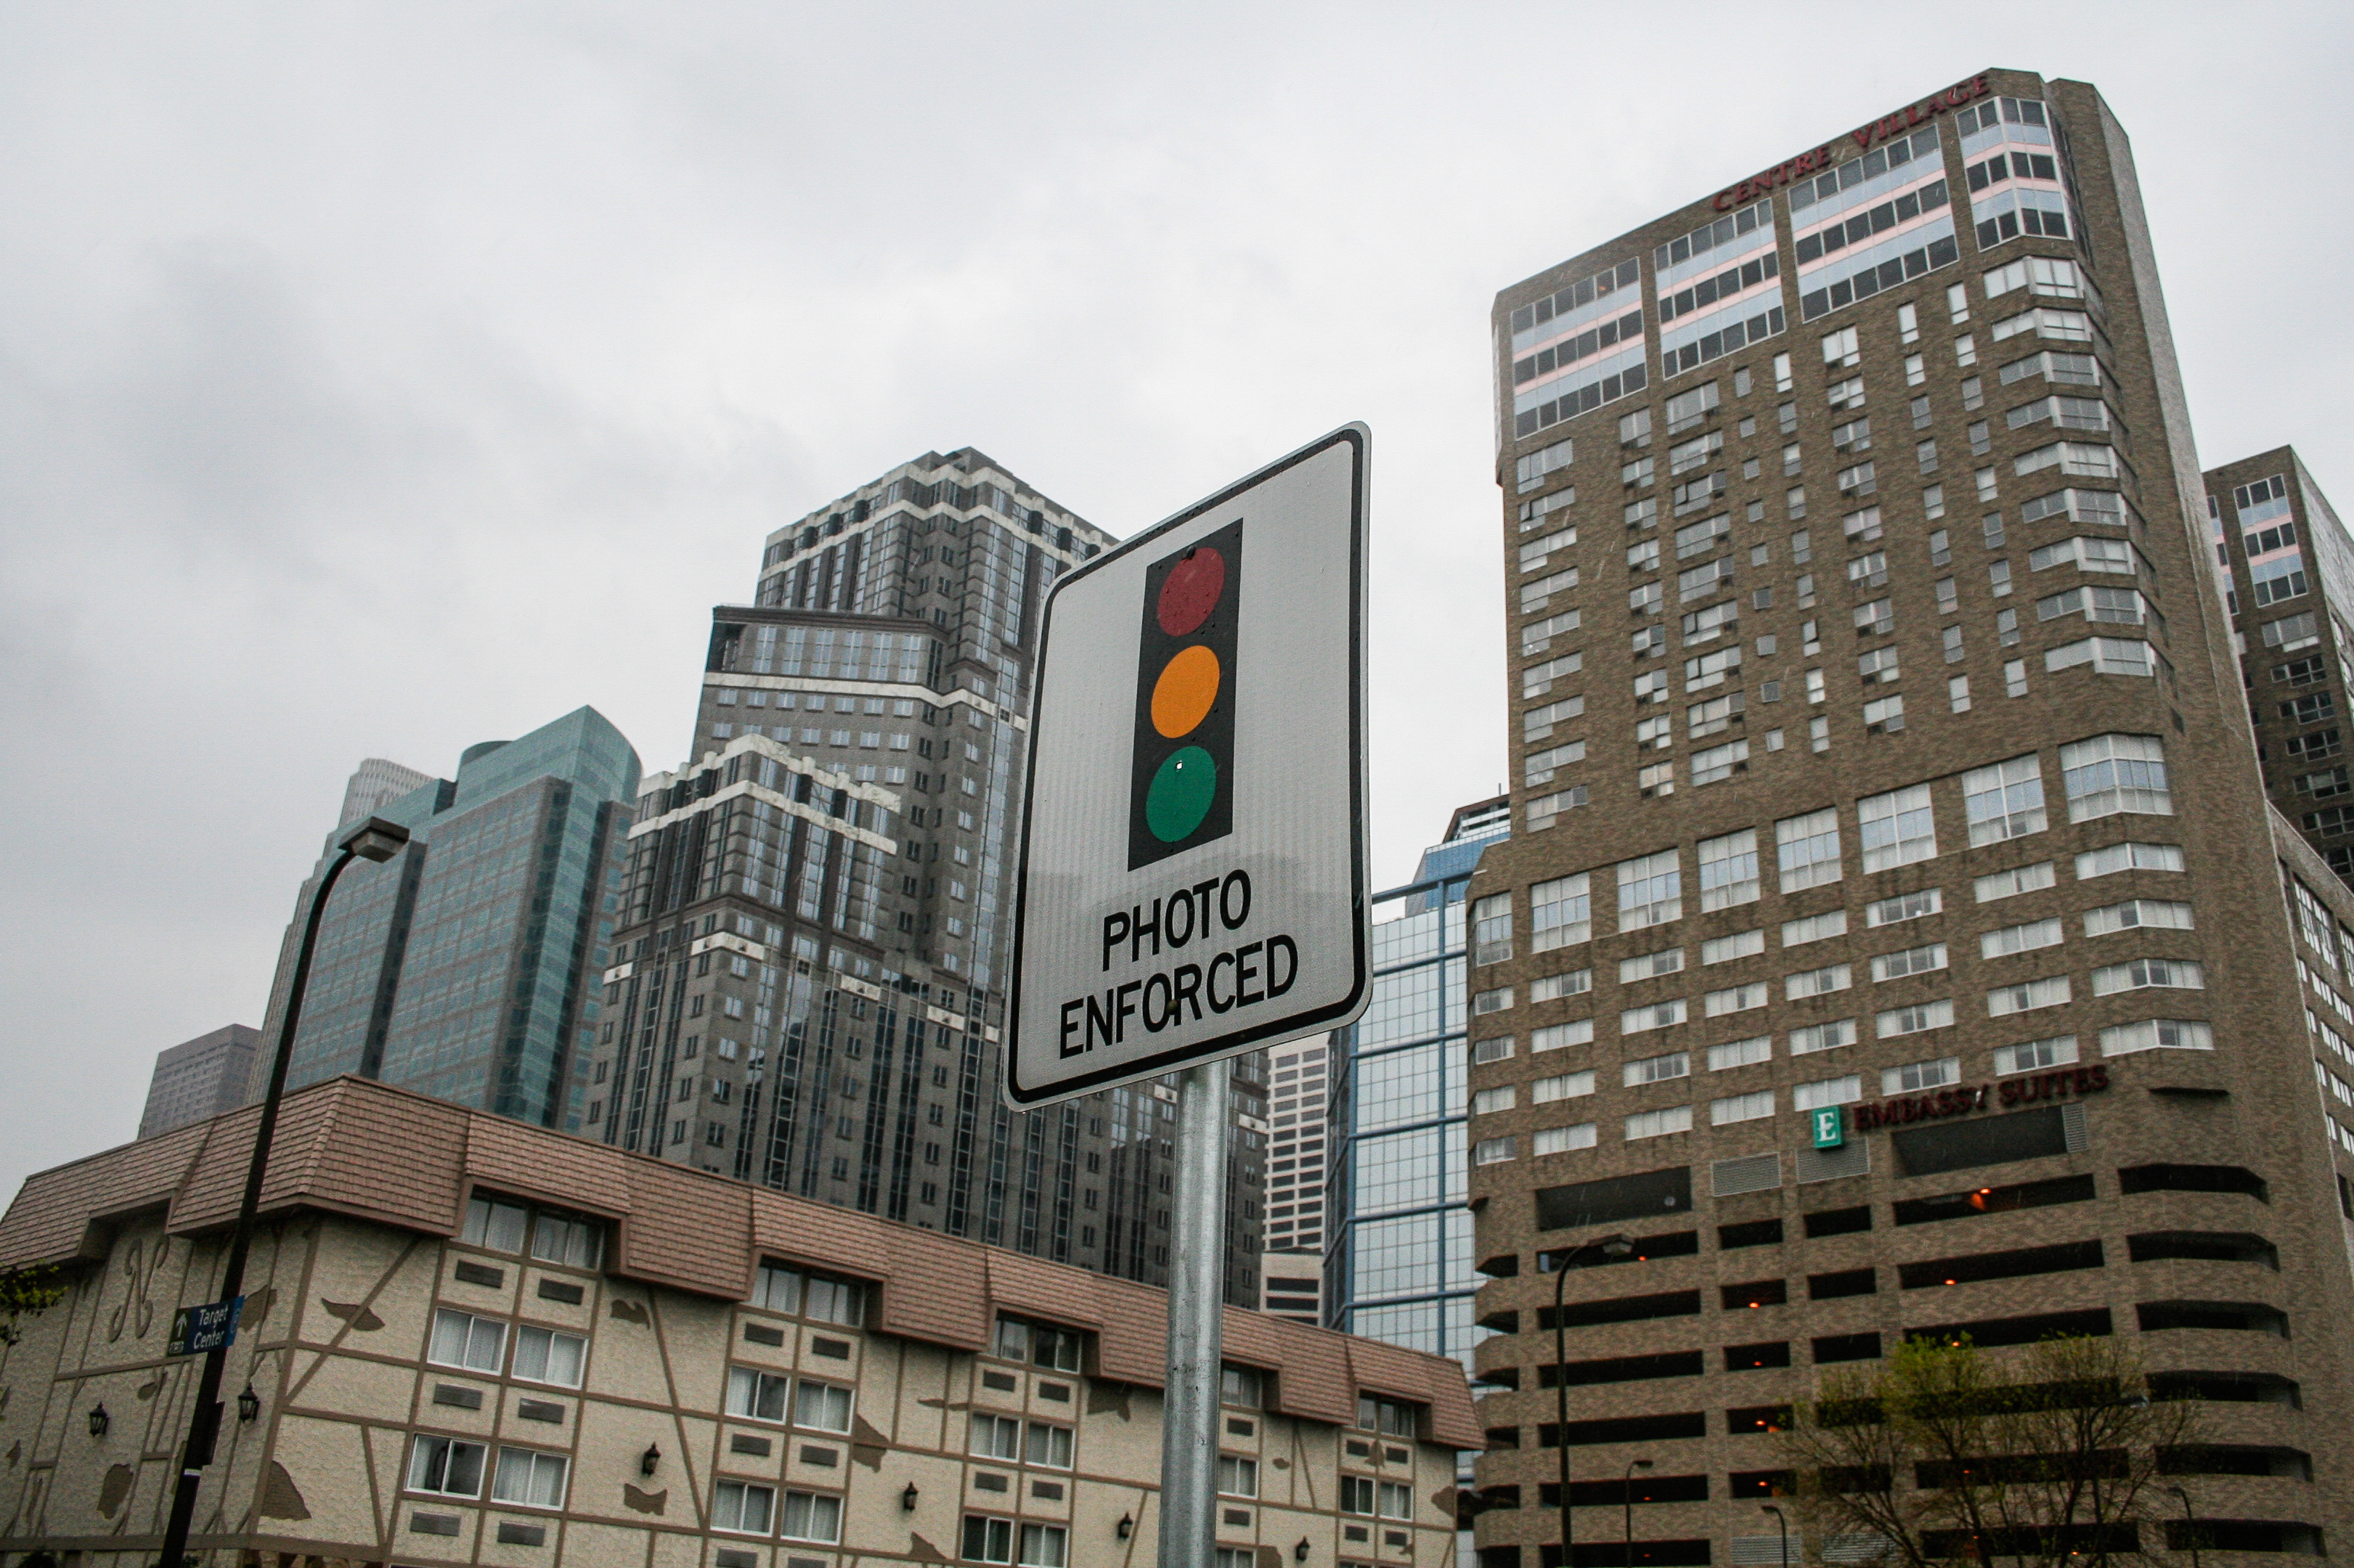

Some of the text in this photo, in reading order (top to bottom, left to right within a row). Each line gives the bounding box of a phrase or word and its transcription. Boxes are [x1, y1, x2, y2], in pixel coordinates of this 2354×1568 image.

[1711, 74, 1990, 211] CENTRE VILLAGE
[1102, 869, 1252, 972] PHOTO
[1059, 934, 1298, 1060] ENFORCED
[1818, 1111, 1837, 1142] E
[1854, 1064, 2109, 1131] EMBASSY SUITES
[193, 1331, 224, 1349] Center
[199, 1304, 229, 1328] Target
